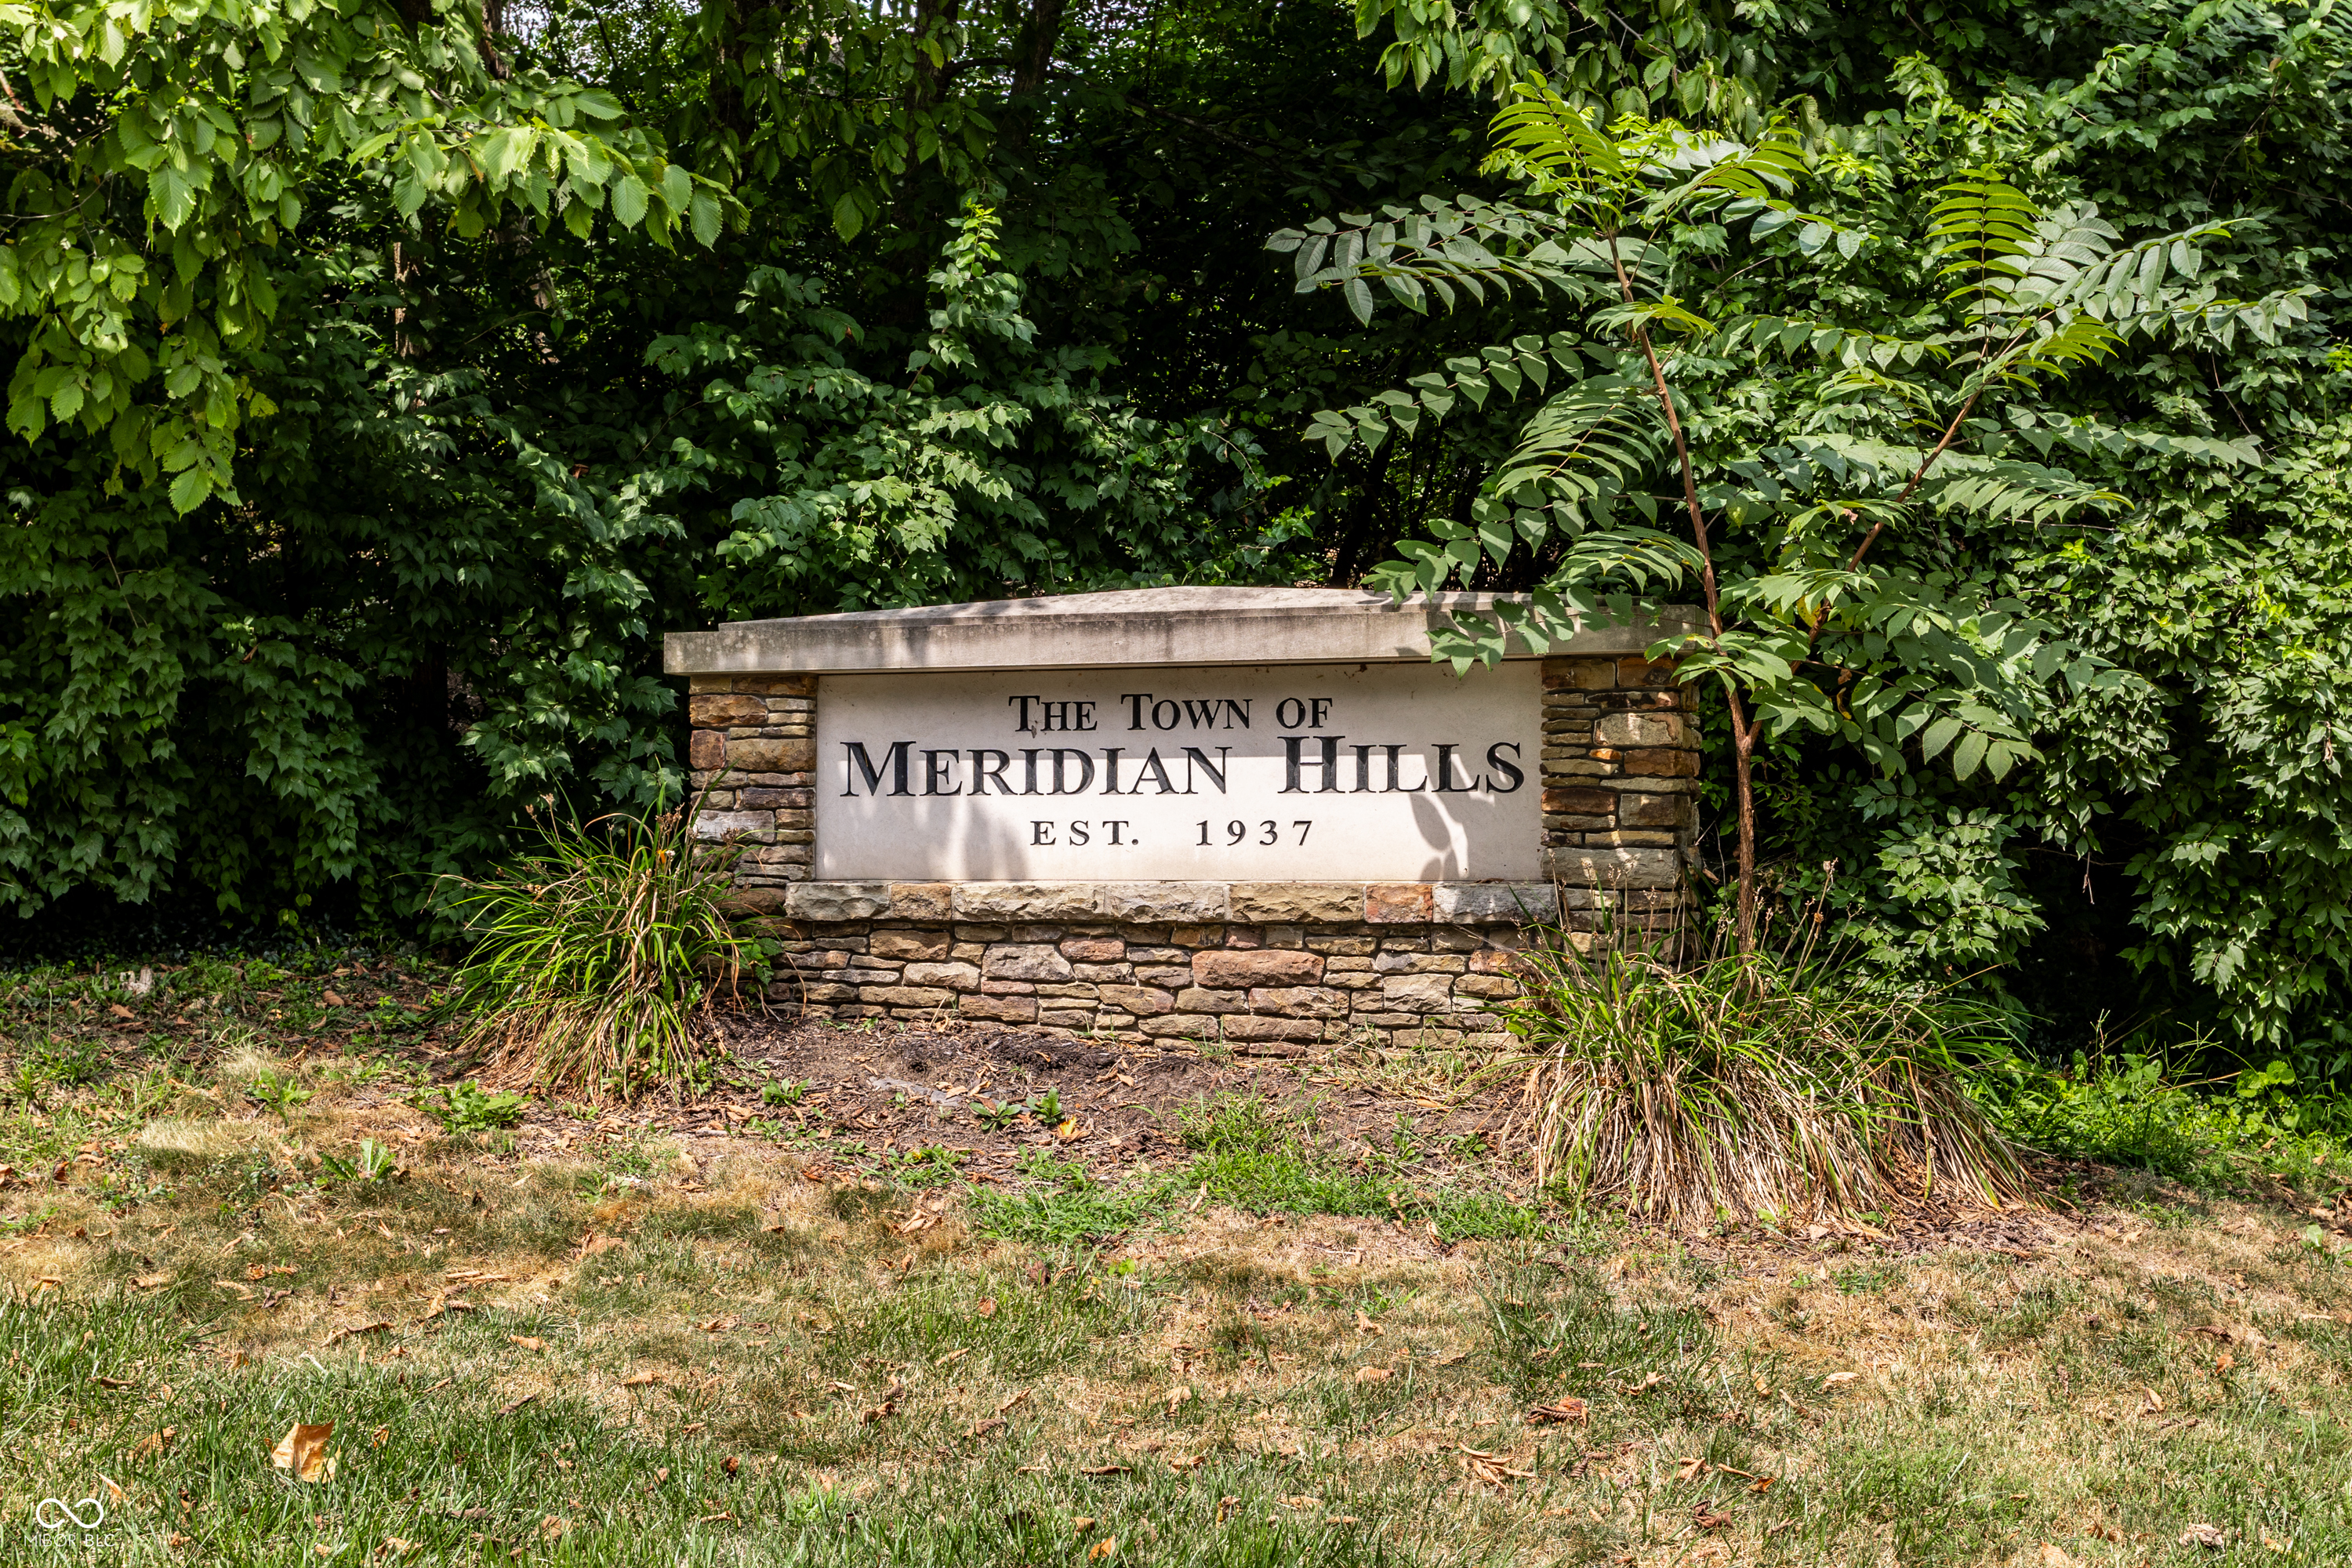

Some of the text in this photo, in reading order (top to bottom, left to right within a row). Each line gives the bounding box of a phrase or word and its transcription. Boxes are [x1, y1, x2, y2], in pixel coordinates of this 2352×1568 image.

[1008, 693, 1333, 732] THE TOWN OF
[840, 735, 1524, 797] MERIDIAN HILLS
[1030, 819, 1313, 846] EST. 1937
